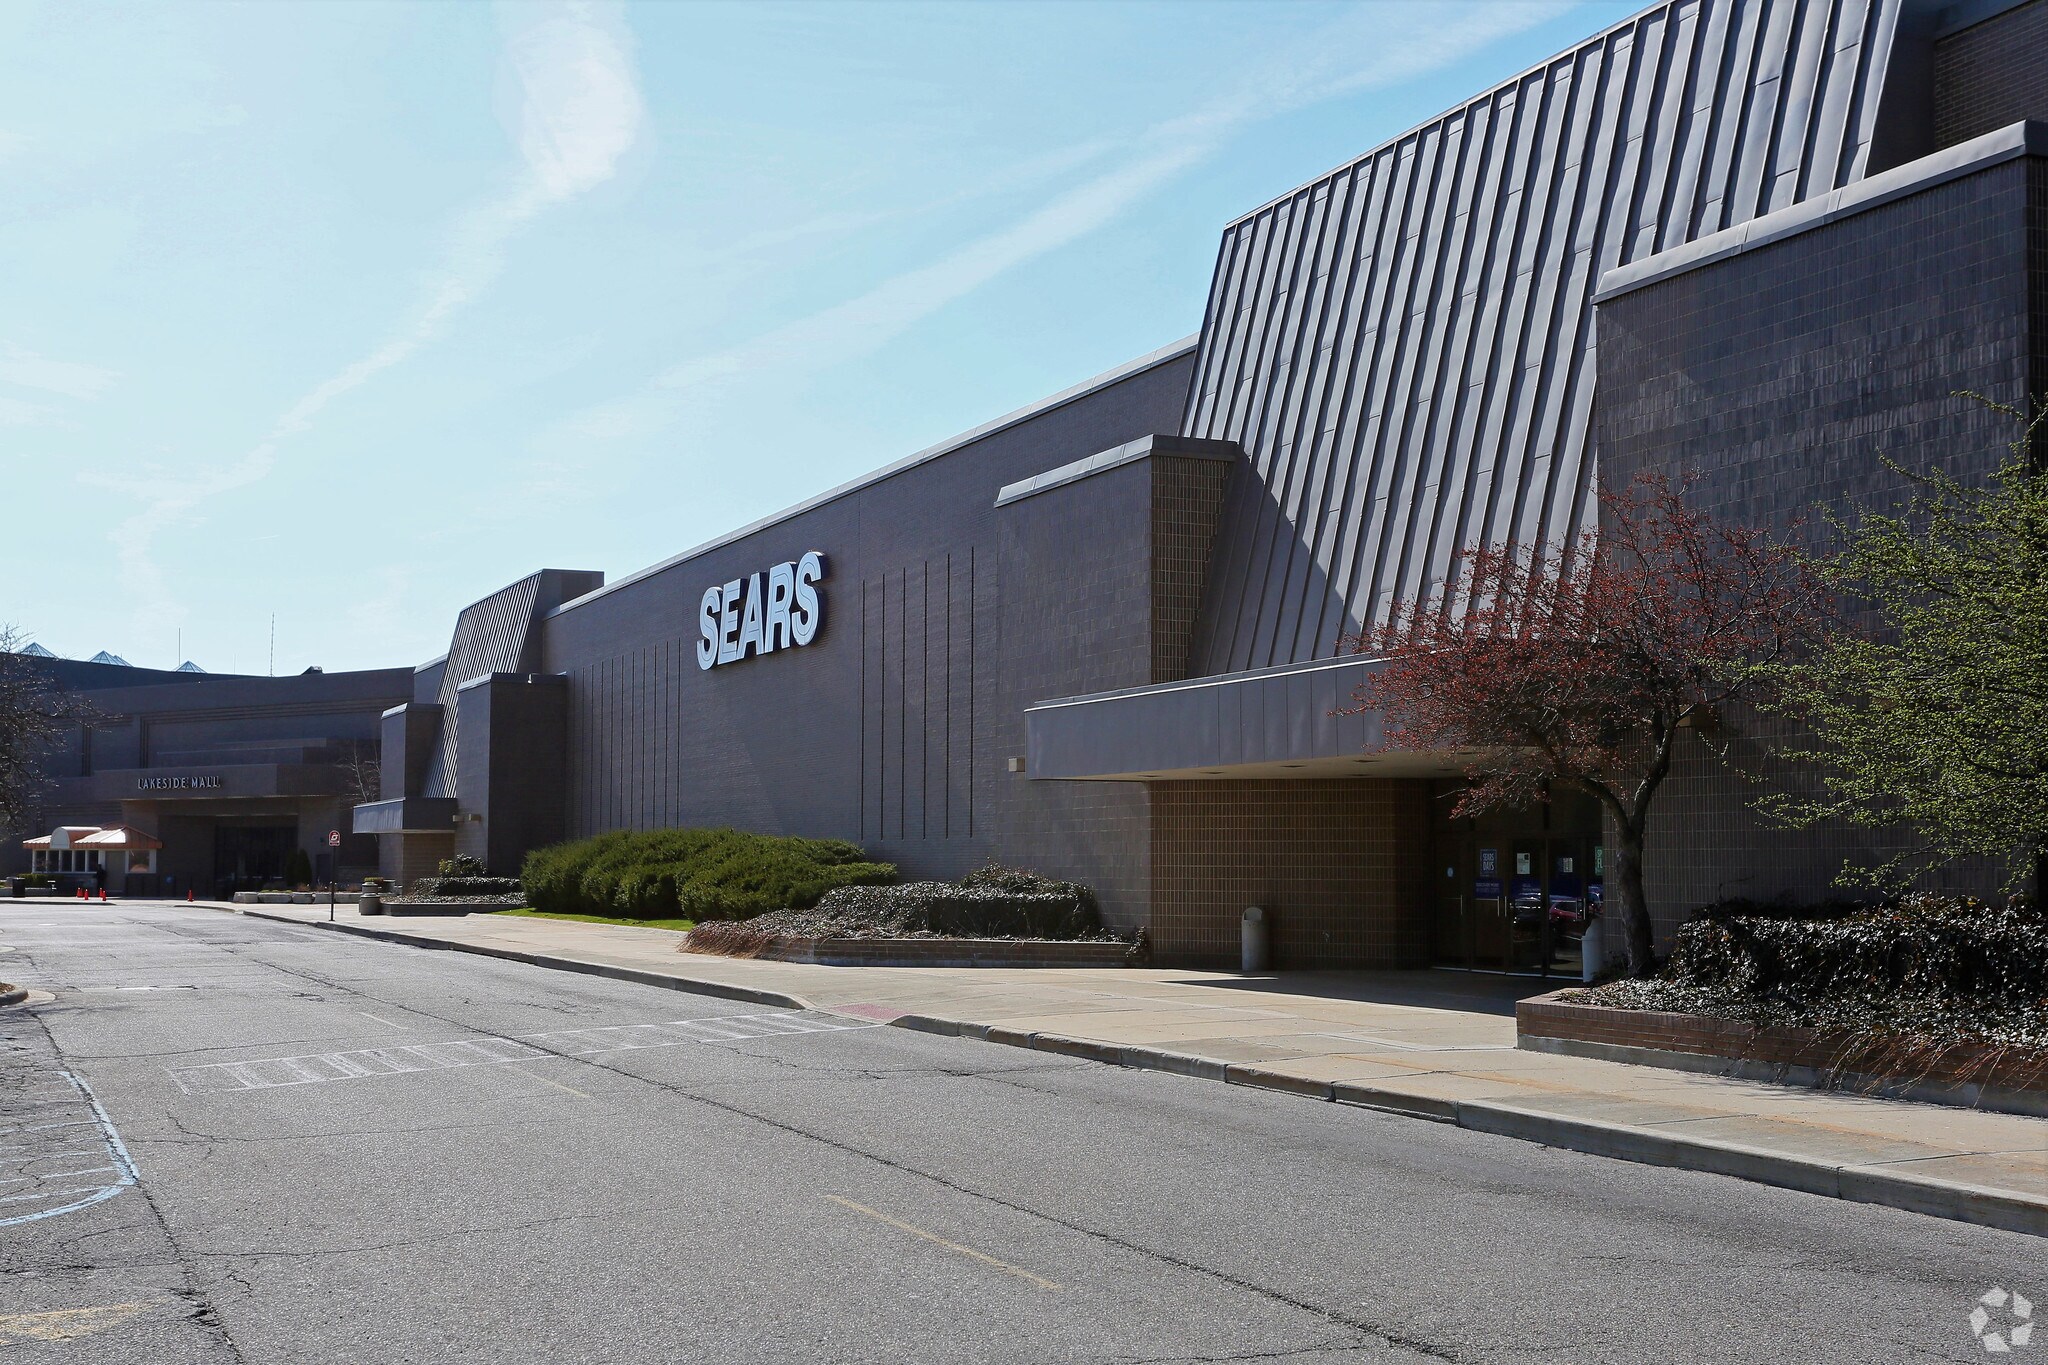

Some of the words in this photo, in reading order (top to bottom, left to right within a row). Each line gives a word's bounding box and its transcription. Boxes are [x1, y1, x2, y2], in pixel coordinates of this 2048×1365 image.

[697, 551, 823, 670] SEARS
[137, 778, 187, 789] LAKESIDE
[191, 776, 219, 788] MALL
